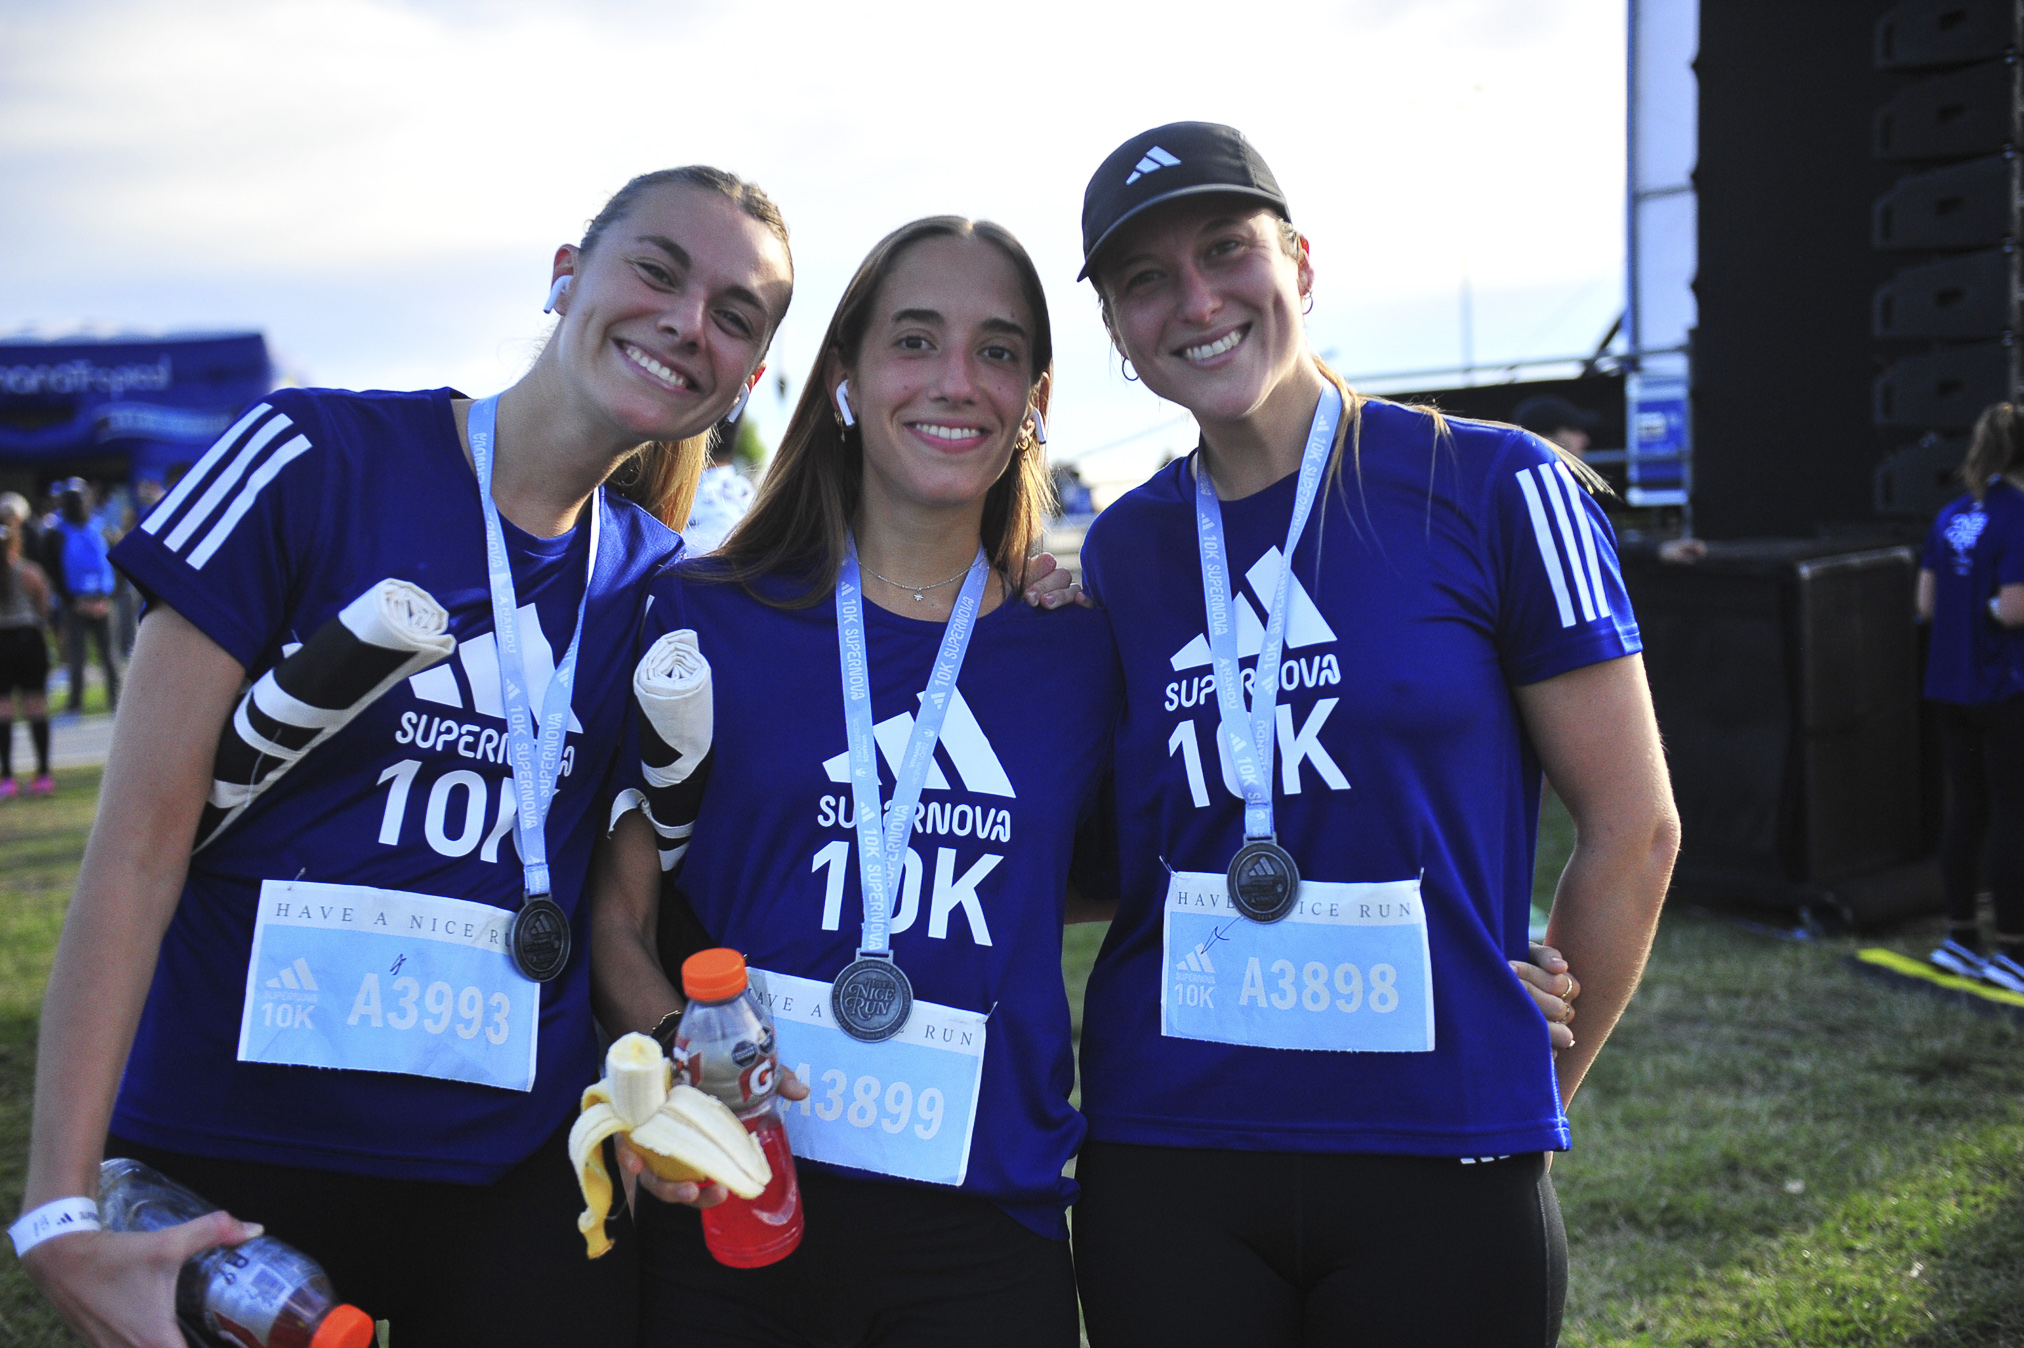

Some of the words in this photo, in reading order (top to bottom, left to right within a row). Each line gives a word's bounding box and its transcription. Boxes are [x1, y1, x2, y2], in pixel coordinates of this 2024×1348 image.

[1308, 436, 1326, 463] 10K
[1293, 464, 1318, 536] SUPERNO
[1203, 535, 1220, 560] 10K
[842, 599, 859, 624] 10K
[1206, 564, 1228, 636] SUPERNOVA
[845, 628, 866, 700] SUPERNOVA
[934, 661, 954, 687] 10K
[944, 596, 975, 659] SUPERNOVA
[1264, 640, 1279, 670] 10K
[1164, 654, 1342, 711] SUPROVA
[510, 705, 527, 736] 10K
[1256, 720, 1266, 763] ANDU
[395, 711, 575, 777] SUPERNA
[539, 713, 563, 798] SUPERNOVA
[516, 743, 538, 830] SUPERNOVA
[1238, 756, 1259, 787] 10K
[817, 795, 1011, 843] SURNOVA
[863, 827, 880, 858] 10K
[275, 903, 354, 922] HAVE
[374, 913, 387, 925] A
[409, 915, 474, 938] NICE
[867, 864, 885, 950] SUPERNOVA
[1177, 891, 1236, 909] HAVE
[1299, 902, 1340, 917] ICE
[1359, 903, 1411, 918] RUN
[848, 981, 895, 1001] NICE
[1175, 983, 1215, 1008] 10K
[1239, 957, 1399, 1014] A3898
[261, 1002, 315, 1030] 10K
[346, 973, 510, 1045] A3993
[747, 988, 794, 1012] AVE
[811, 1004, 823, 1017] A
[925, 1025, 974, 1046] RUN
[845, 997, 891, 1020] RUN
[783, 1062, 944, 1140] A3899
